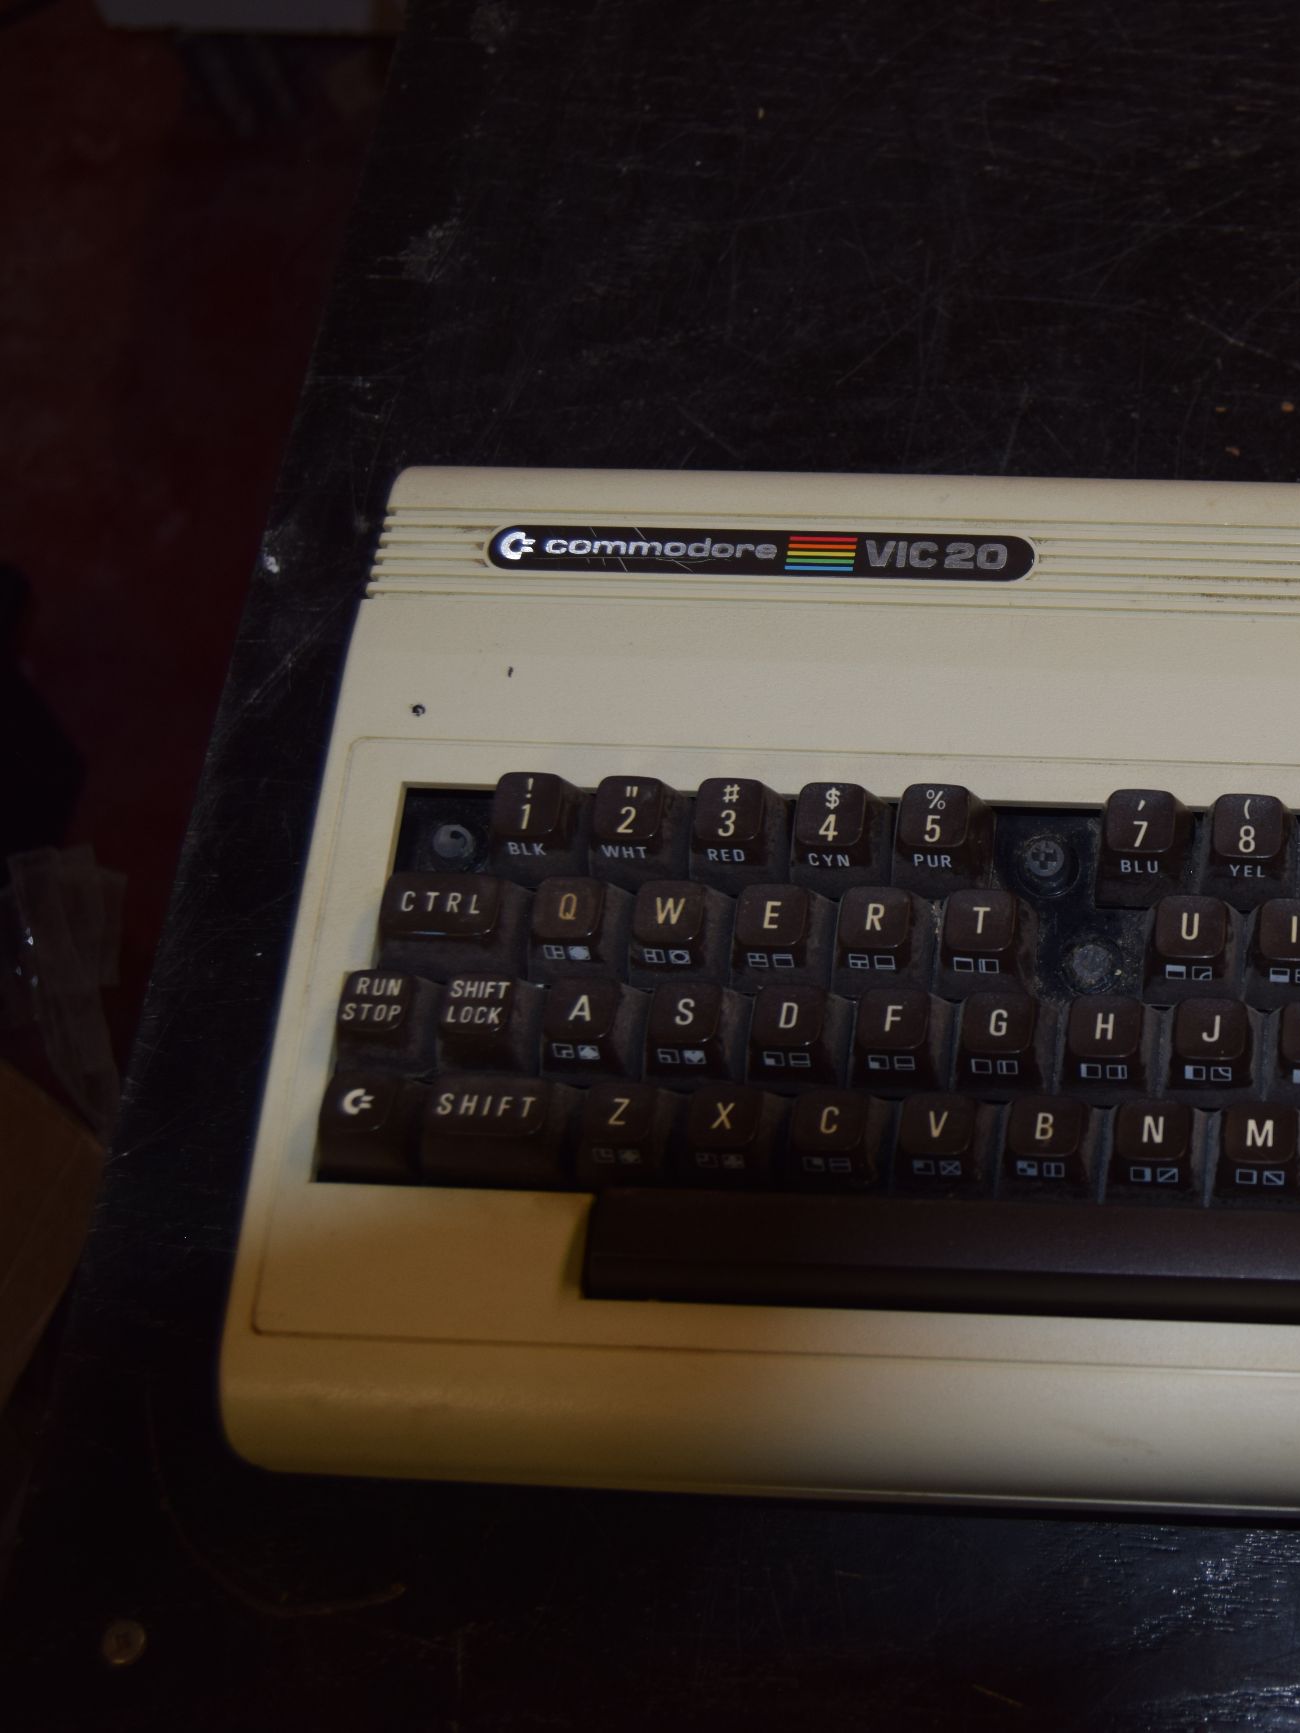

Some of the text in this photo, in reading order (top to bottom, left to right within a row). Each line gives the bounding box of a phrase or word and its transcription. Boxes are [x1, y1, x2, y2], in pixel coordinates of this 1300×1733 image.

[545, 537, 1008, 569] commodore VIC 20
[723, 784, 740, 803] #
[825, 788, 839, 809] $
[926, 789, 946, 810] %
[520, 804, 532, 830] 1
[617, 806, 637, 834] 2
[718, 811, 736, 837] 3
[819, 815, 838, 842] 4
[924, 815, 941, 843] 5
[1132, 821, 1148, 848] 7
[1239, 825, 1256, 853] 8
[508, 842, 546, 856] BLK
[601, 844, 647, 859] WHT
[708, 848, 745, 862] RED
[808, 852, 850, 868] CYN
[914, 854, 952, 868] PUR
[1121, 859, 1158, 874] BLU
[1229, 864, 1266, 878] YEL
[401, 891, 481, 915] CTRL
[559, 893, 578, 921] Q
[655, 897, 685, 925] W
[763, 901, 782, 929] E
[866, 903, 885, 931] R
[972, 907, 991, 934] T
[1181, 912, 1199, 941] U
[1291, 915, 1298, 943] I
[356, 977, 402, 996] RUN
[451, 980, 510, 999] SHIFT
[342, 1002, 401, 1022] STOP
[446, 1005, 502, 1025] LOCK
[569, 994, 591, 1022] A
[676, 998, 695, 1026] S
[779, 1002, 799, 1029] D
[884, 1005, 902, 1032] F
[989, 1009, 1008, 1037] G
[1095, 1012, 1114, 1040] H
[1202, 1015, 1221, 1042] J
[436, 1092, 536, 1118] SHIFT
[608, 1098, 630, 1125] Z
[711, 1102, 735, 1130] X
[820, 1106, 839, 1134] C
[929, 1111, 948, 1138] V
[1035, 1112, 1054, 1140] B
[1142, 1116, 1164, 1144] N
[1246, 1119, 1274, 1148] M
